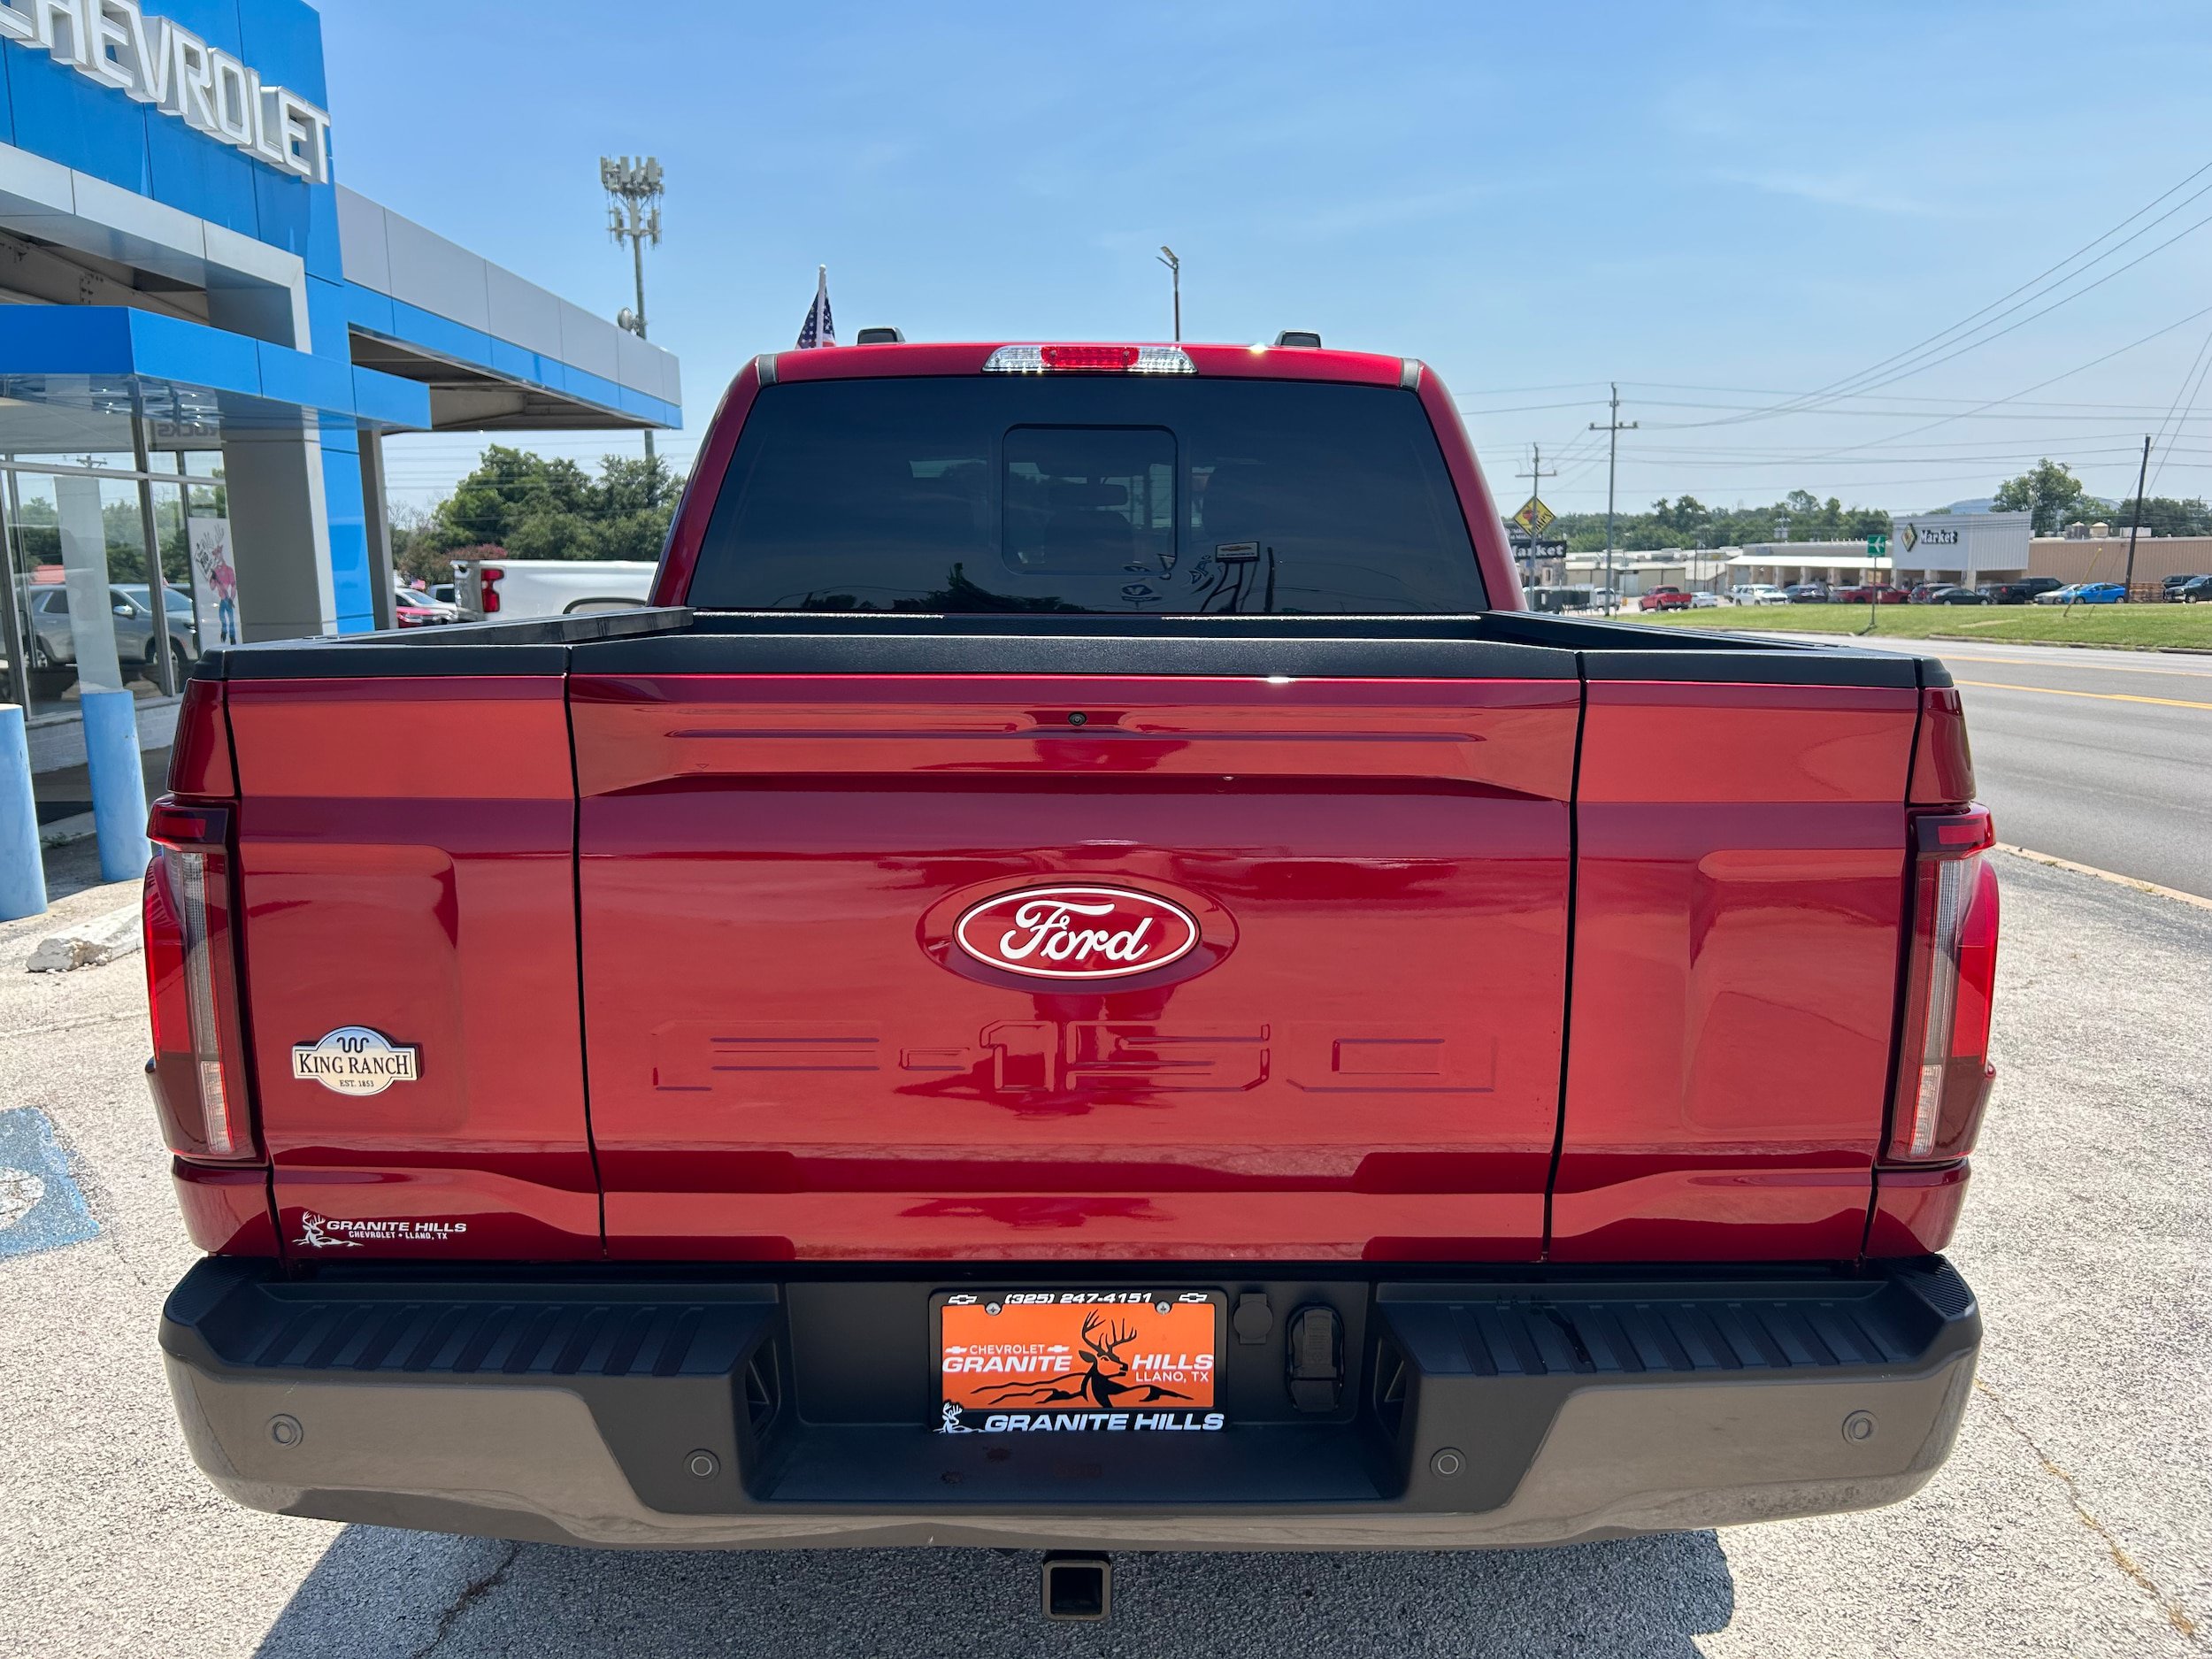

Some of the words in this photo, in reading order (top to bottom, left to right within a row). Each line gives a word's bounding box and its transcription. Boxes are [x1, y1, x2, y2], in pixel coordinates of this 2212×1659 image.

[1920, 530, 1956, 543] Market
[999, 900, 1153, 961] Ford
[652, 1020, 1496, 1092] F-150
[299, 1053, 343, 1073] KING
[348, 1055, 410, 1075] RANCH
[326, 1220, 410, 1232] GRANITE
[415, 1222, 467, 1233] HILLS
[1004, 1293, 1054, 1304] (325)
[1060, 1293, 1152, 1304] 247-4151
[970, 1344, 1045, 1356] CHEVROLET
[942, 1356, 1073, 1372] GRANITE
[1132, 1354, 1215, 1371] HILLS
[1135, 1371, 1187, 1383] LLANO,
[1191, 1371, 1210, 1382] TX
[984, 1414, 1129, 1432] GRANITE
[1133, 1413, 1225, 1431] HILLS
